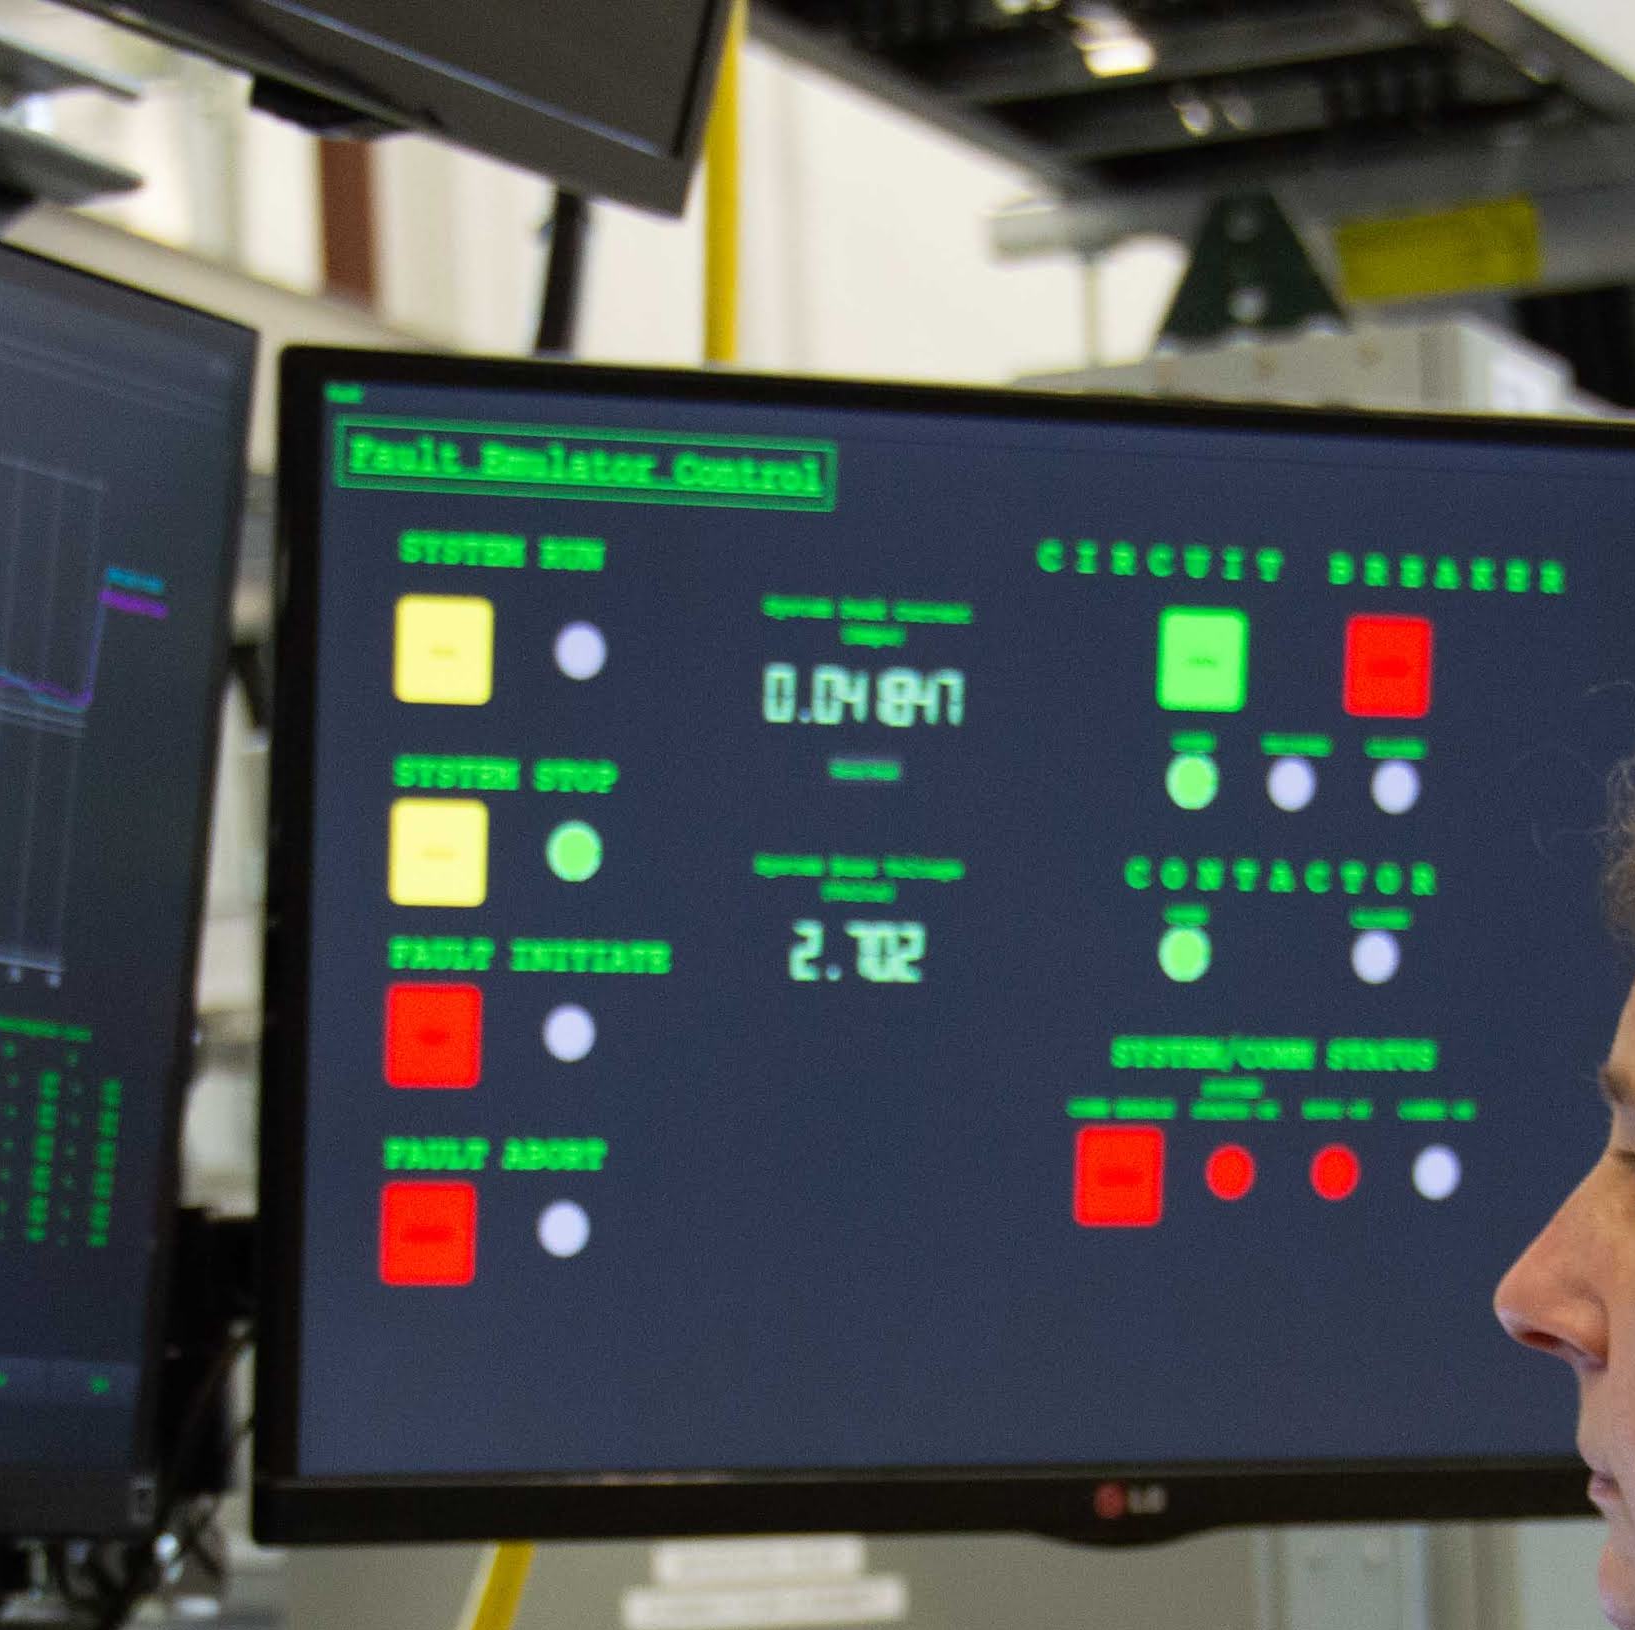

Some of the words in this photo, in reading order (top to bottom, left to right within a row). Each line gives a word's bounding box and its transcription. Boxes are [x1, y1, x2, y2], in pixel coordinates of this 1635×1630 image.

[349, 433, 463, 476] Fault
[480, 441, 660, 485] Emulator
[672, 450, 823, 495] Control
[398, 530, 526, 568] SYSTEM
[1036, 538, 1284, 583] CIRCUIT
[1328, 551, 1564, 594] BREAKER
[393, 754, 521, 791] SYSTEM
[533, 758, 620, 794] STOP
[1124, 855, 1436, 897] CONTACTOR
[388, 935, 496, 971] FAULT
[510, 938, 672, 975] INITIATE
[1325, 1038, 1438, 1072] STATUS
[383, 1136, 491, 1171] FAULT
[502, 1137, 609, 1172] ABORT
